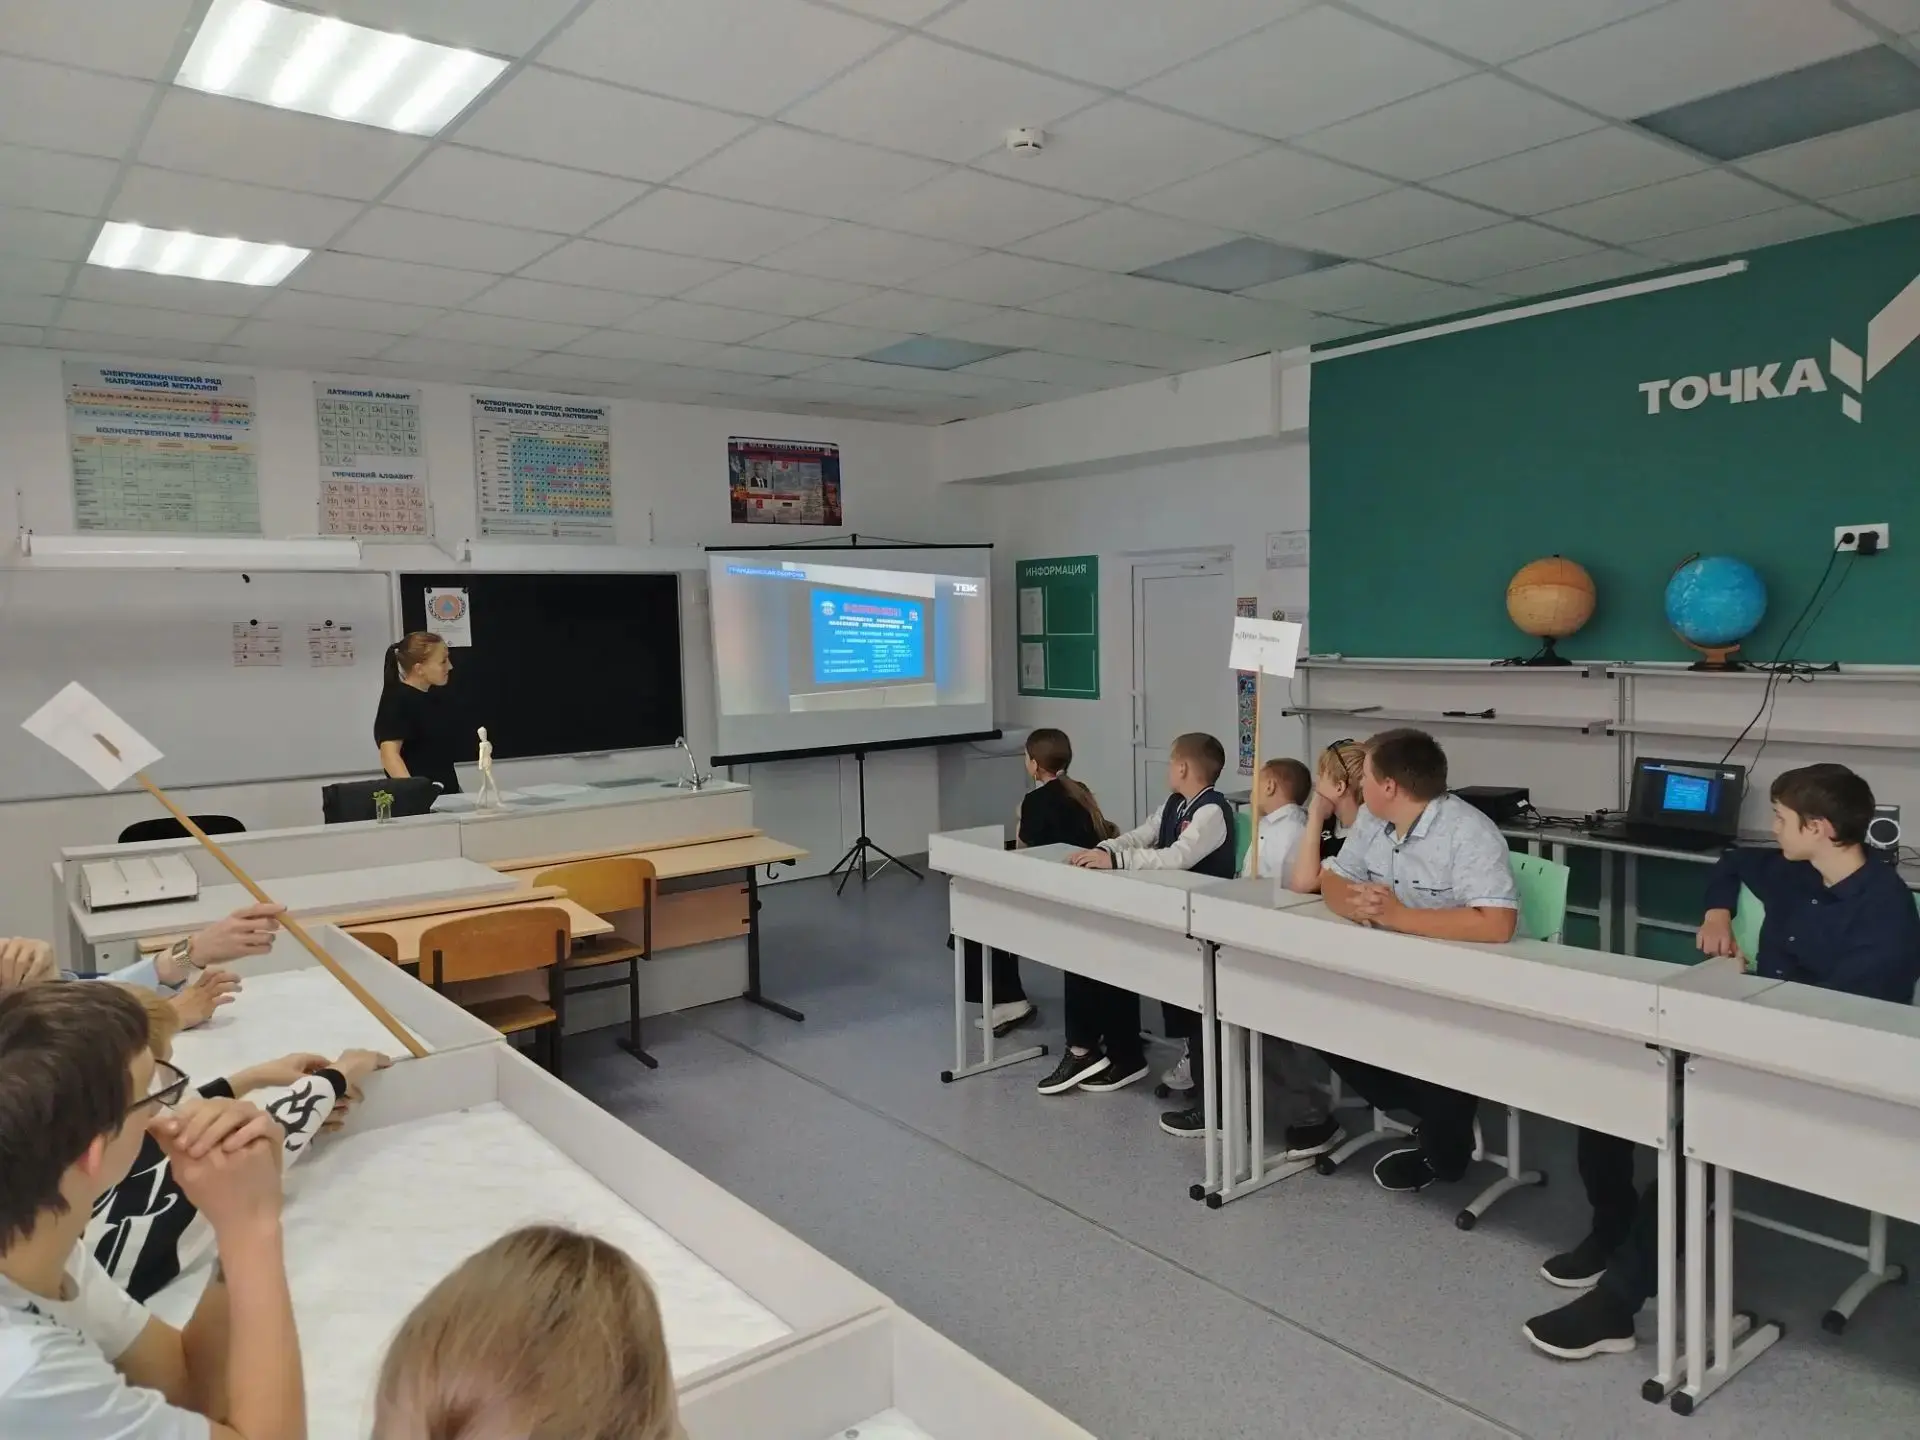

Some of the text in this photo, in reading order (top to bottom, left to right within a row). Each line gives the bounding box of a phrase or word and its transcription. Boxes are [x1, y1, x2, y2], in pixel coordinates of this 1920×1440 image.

[100, 369, 223, 387] ЭЛЕКТРОХИМИЧЕСКИЙ РЯД
[104, 377, 169, 389] НАПРЯЖЕНИЙ
[171, 382, 219, 393] МЕТАЛЛОВ
[1638, 357, 1828, 415] ТОЧКА
[96, 426, 233, 441] КОЛИЧЕСТВЕННЫЕ ВЕЛИЧИНЫ
[1025, 564, 1087, 577] ИНФОРМАЦИЯ
